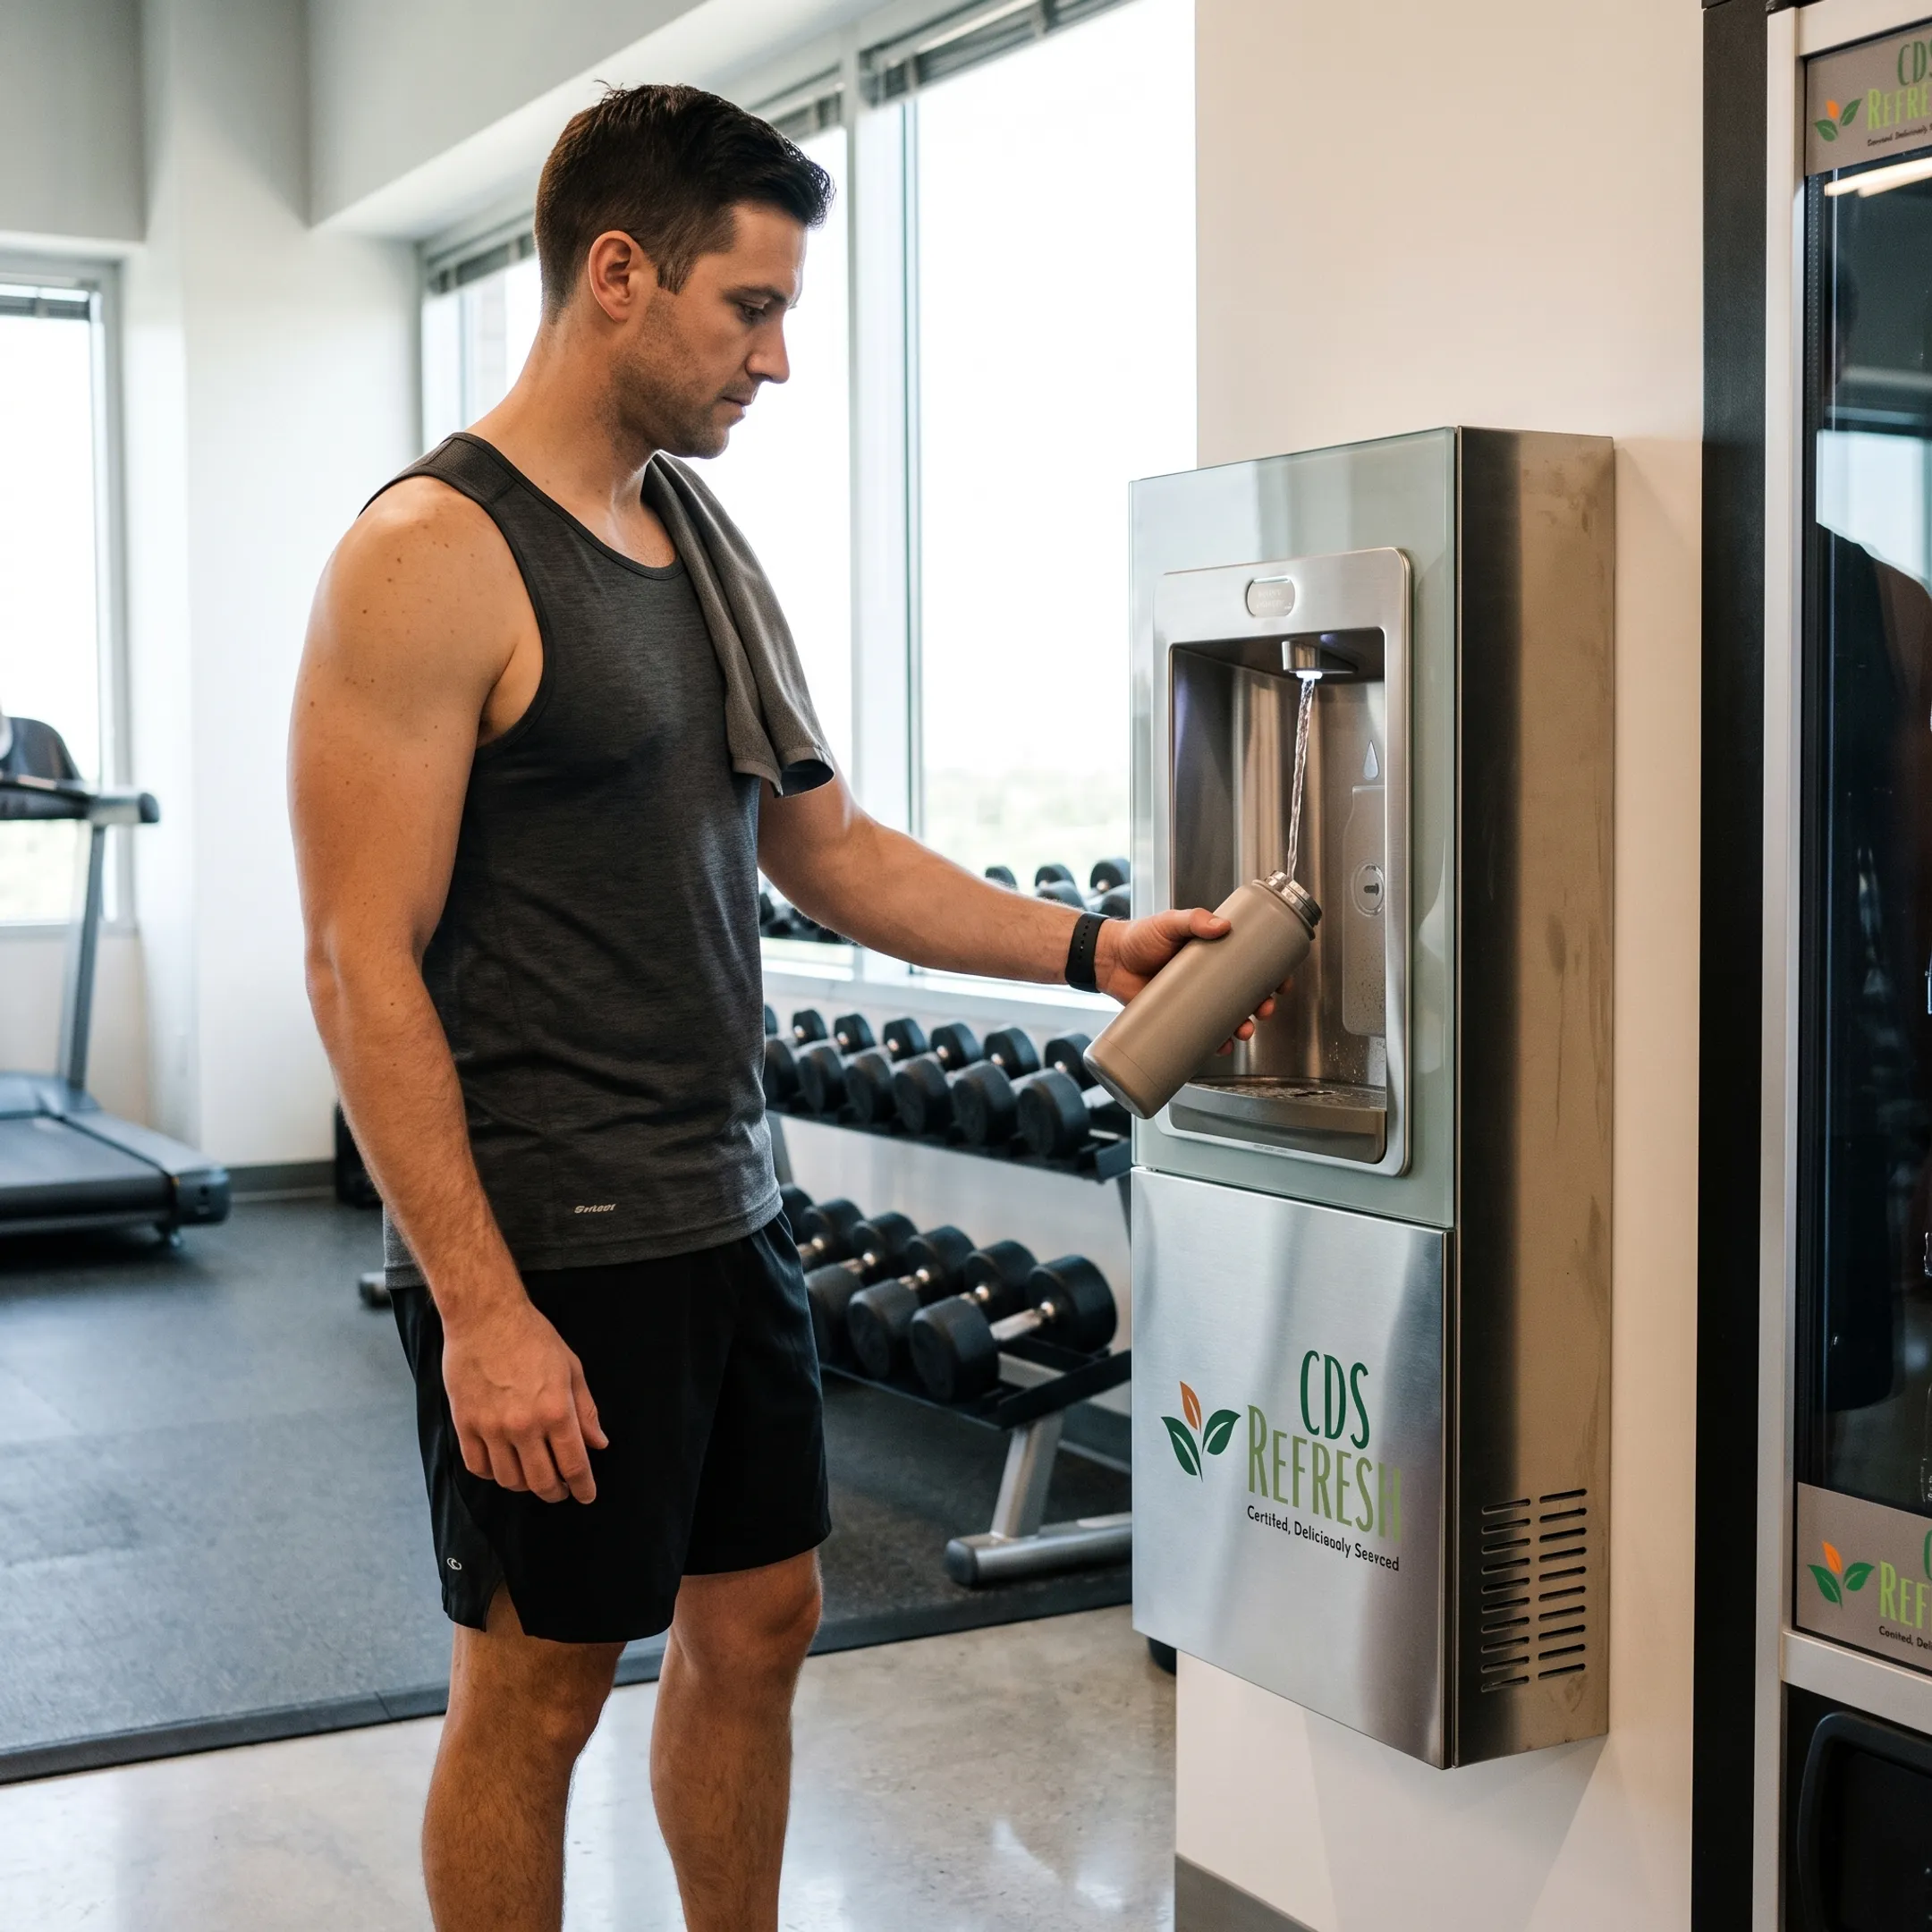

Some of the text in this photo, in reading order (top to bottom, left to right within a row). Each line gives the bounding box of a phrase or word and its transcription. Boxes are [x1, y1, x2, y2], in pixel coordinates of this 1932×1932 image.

[1897, 38, 1932, 86] CD
[1300, 1350, 1370, 1450] CDS
[1247, 1404, 1402, 1543] REFRESH
